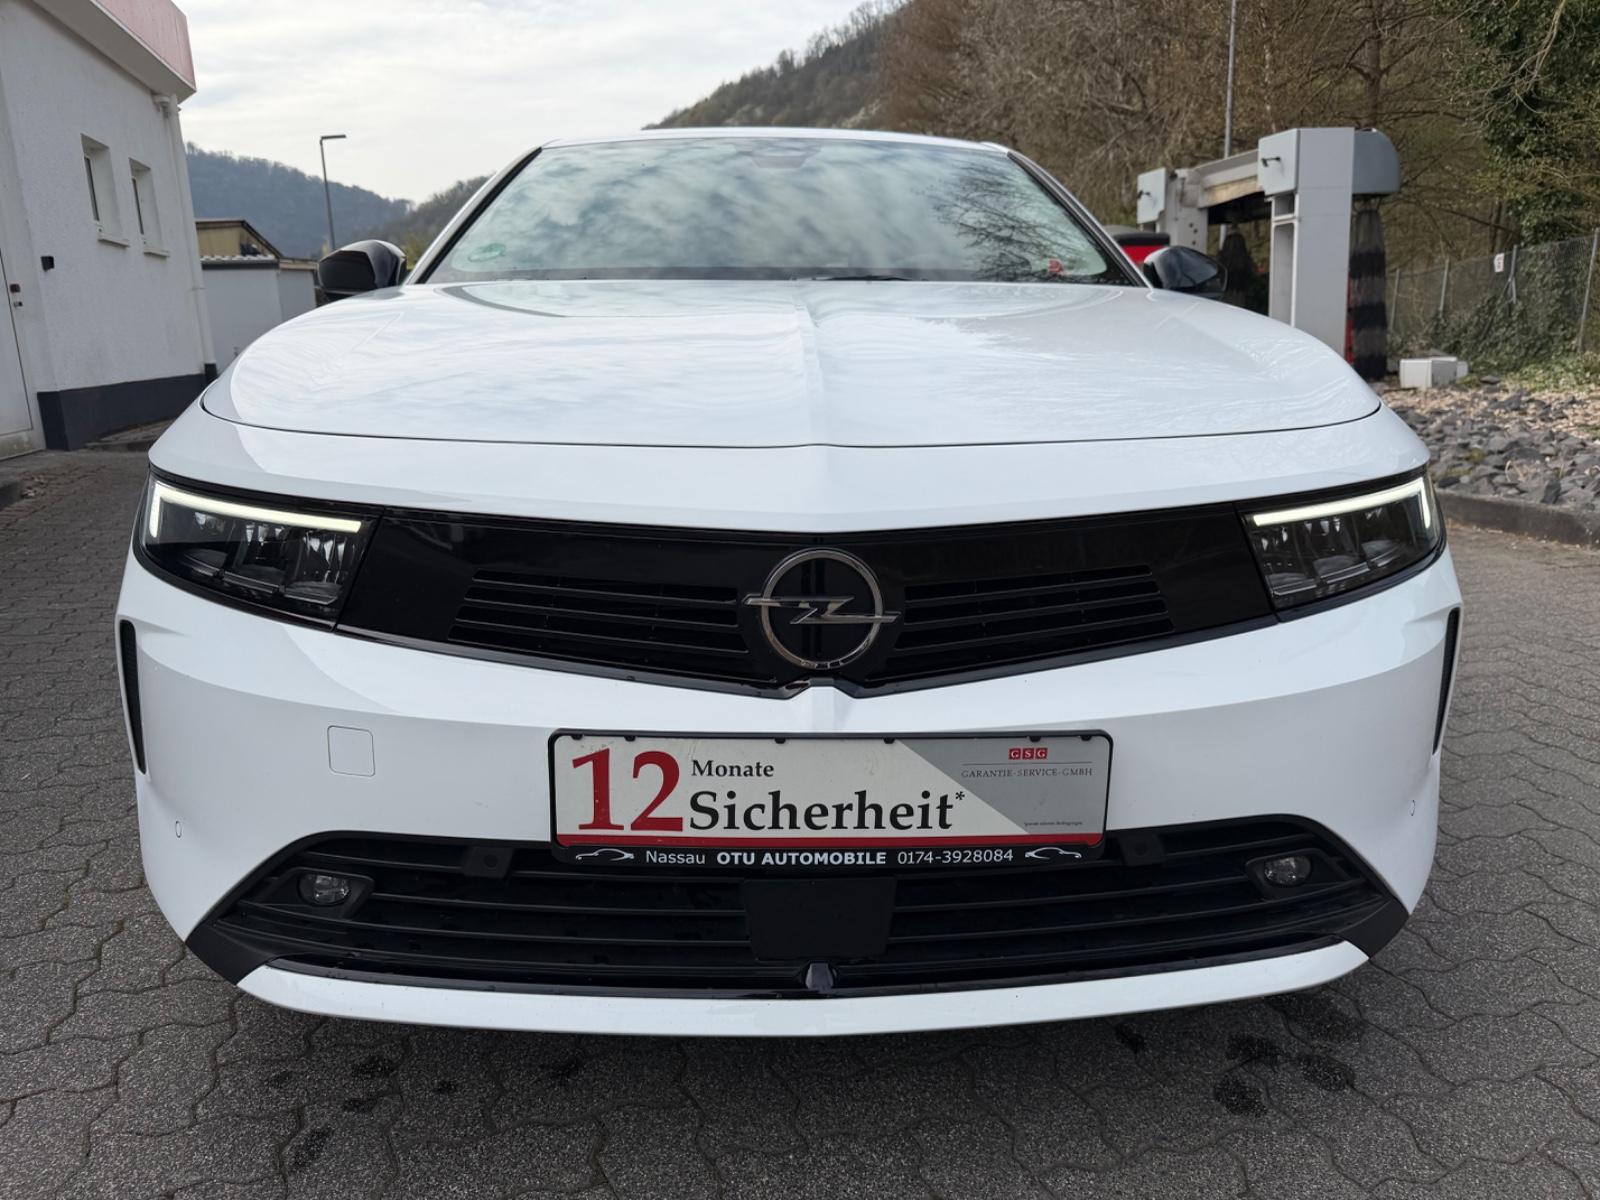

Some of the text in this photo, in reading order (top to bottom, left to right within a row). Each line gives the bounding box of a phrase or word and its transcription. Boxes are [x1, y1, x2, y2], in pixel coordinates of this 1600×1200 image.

[1010, 749, 1047, 759] GSG
[691, 760, 774, 777] Monate
[572, 748, 683, 831] 12
[646, 849, 1014, 865] Nassau OTU AUTOMOBILE 0174-3928084
